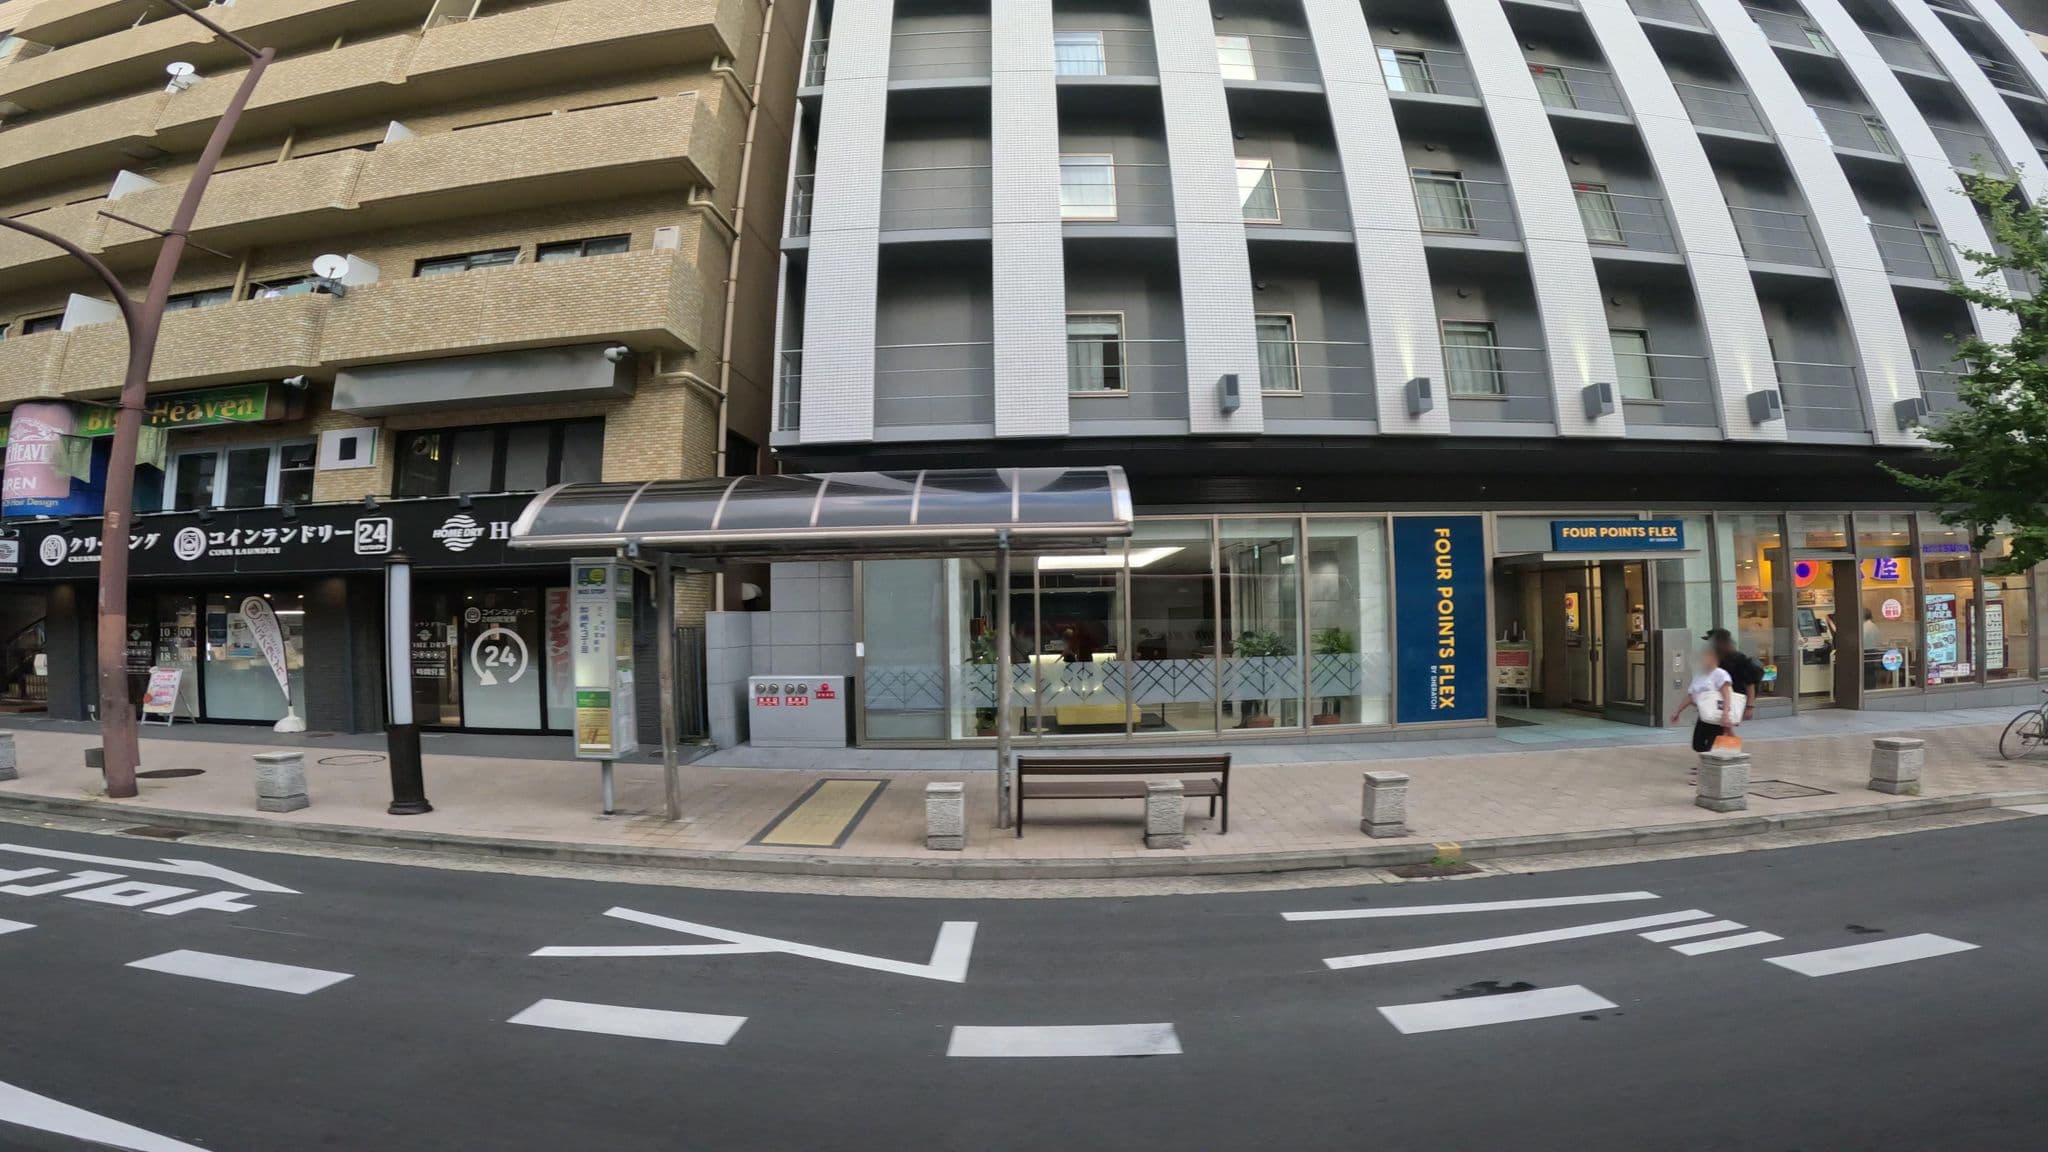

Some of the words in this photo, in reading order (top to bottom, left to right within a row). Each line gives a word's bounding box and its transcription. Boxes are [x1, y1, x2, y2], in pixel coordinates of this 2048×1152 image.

[152, 398, 256, 424] Heaven
[209, 525, 353, 546] コインランドリー
[359, 524, 386, 543] 24
[432, 529, 463, 538] HOME
[463, 527, 486, 537] DRY
[1562, 527, 1597, 538] FOUR
[1600, 527, 1646, 537] POINTS
[1648, 526, 1678, 537] FLEX
[1434, 527, 1453, 580] FOUR
[1437, 586, 1456, 659] POINTS
[485, 645, 517, 668] 24
[1431, 665, 1437, 674] BY
[1430, 675, 1438, 710] SHERATON
[1439, 664, 1456, 709] FLEX
